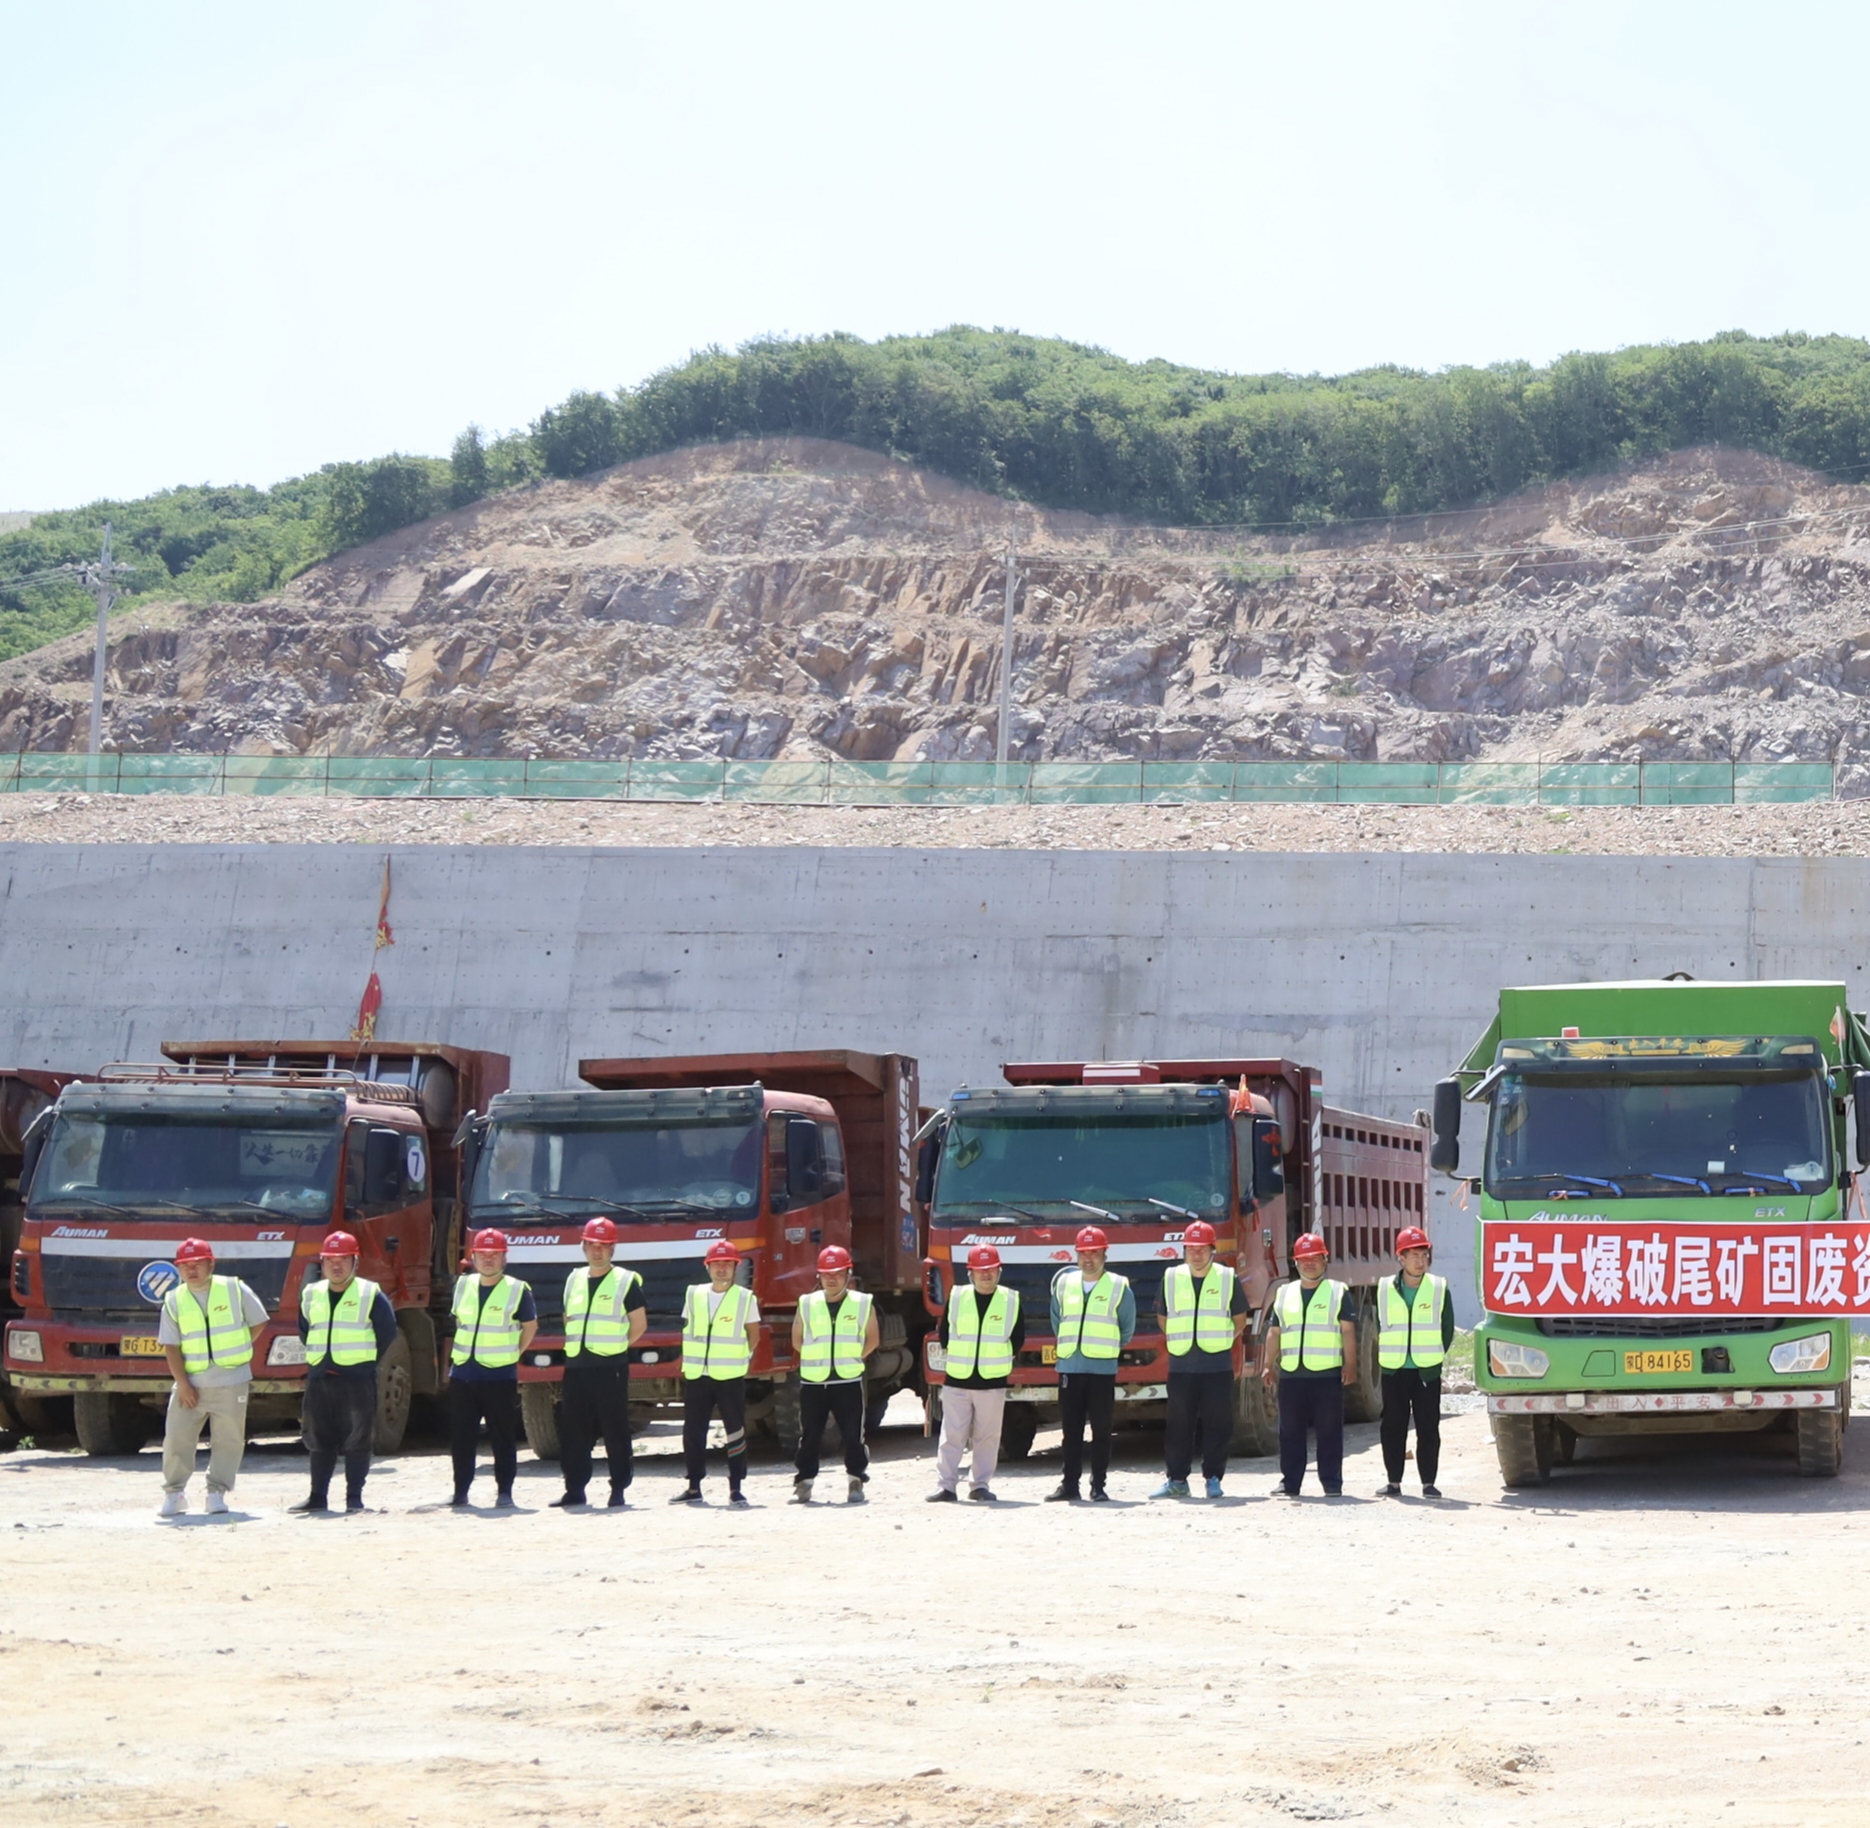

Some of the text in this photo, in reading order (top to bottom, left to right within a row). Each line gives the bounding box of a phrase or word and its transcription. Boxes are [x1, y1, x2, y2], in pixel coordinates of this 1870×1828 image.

[411, 1151, 420, 1177] 7
[1754, 1206, 1786, 1218] ETX
[51, 1226, 109, 1238] AUMAN
[257, 1231, 285, 1241] ETX
[695, 1228, 723, 1238] ETX
[960, 1233, 1016, 1245] AUMAN
